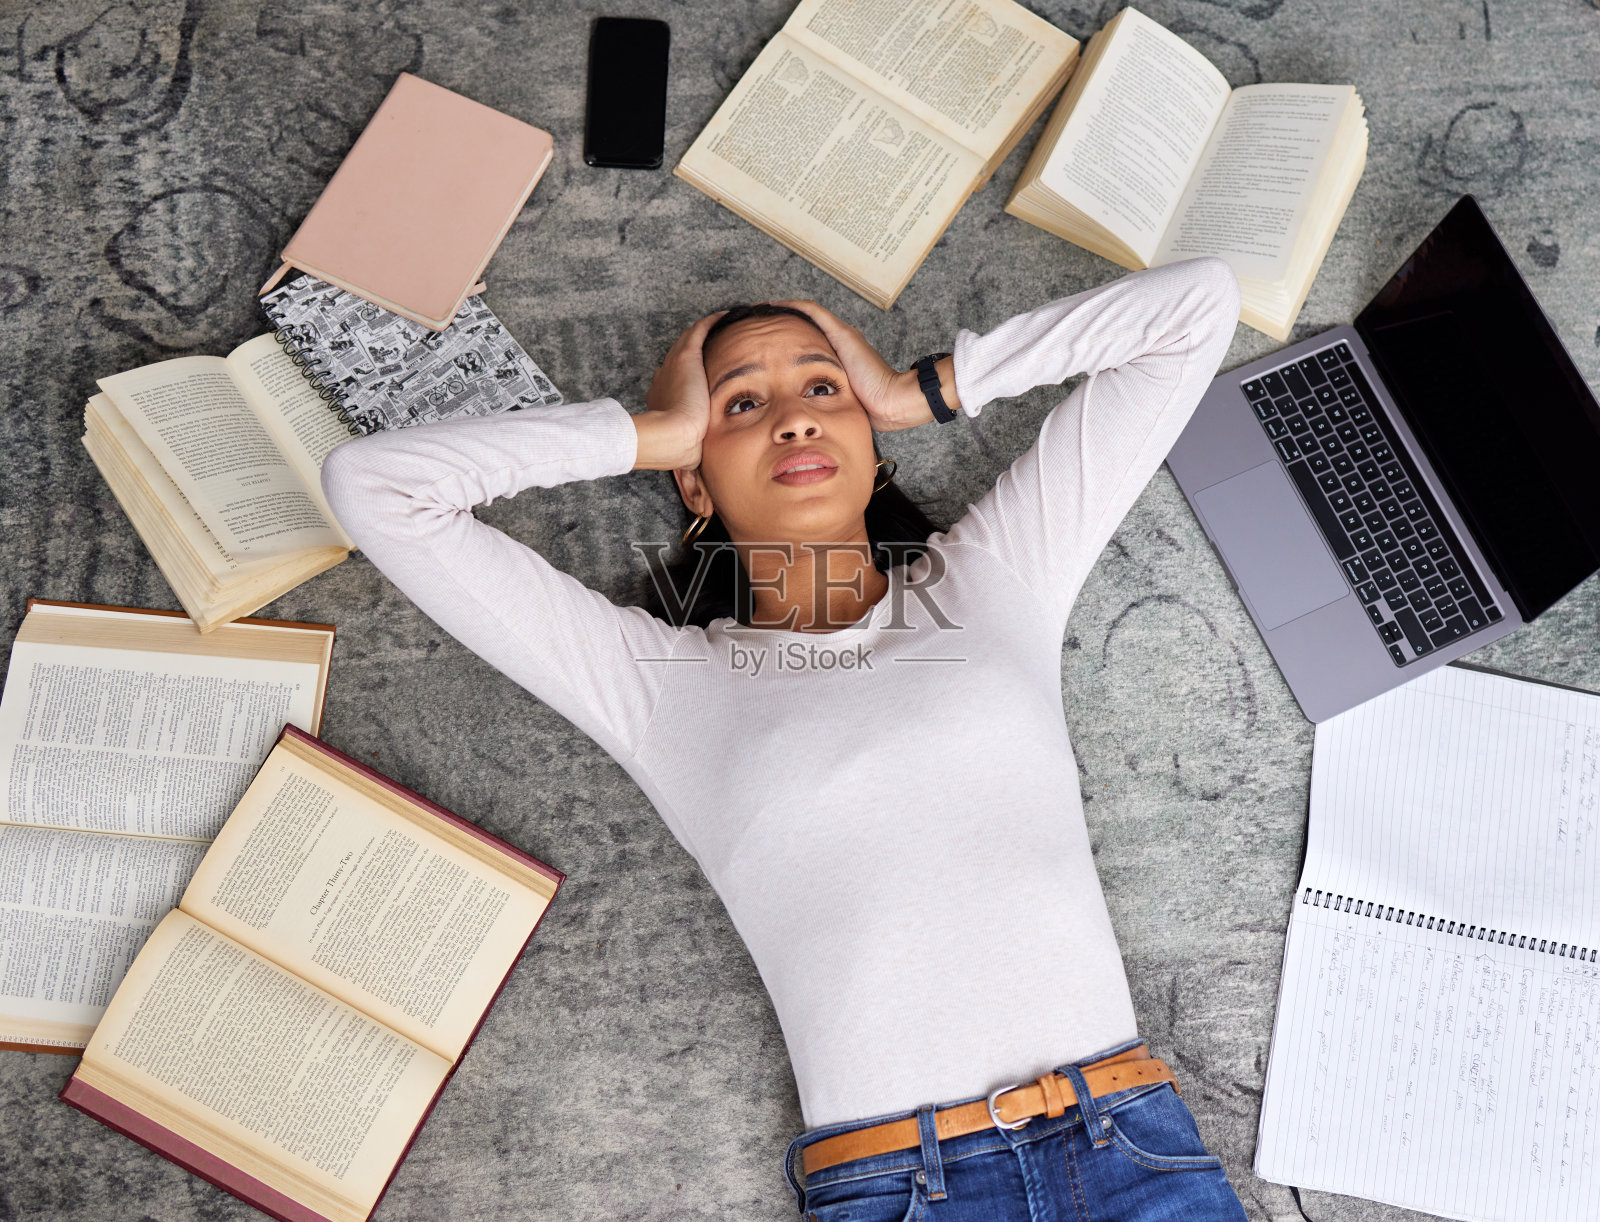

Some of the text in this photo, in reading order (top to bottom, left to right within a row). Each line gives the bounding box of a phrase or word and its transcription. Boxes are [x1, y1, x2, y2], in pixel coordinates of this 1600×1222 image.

[1278, 442, 1290, 459] command
[1346, 563, 1358, 581] command
[309, 851, 352, 915] Chapter Thirty-Two
[1515, 967, 1534, 1016] Composition
